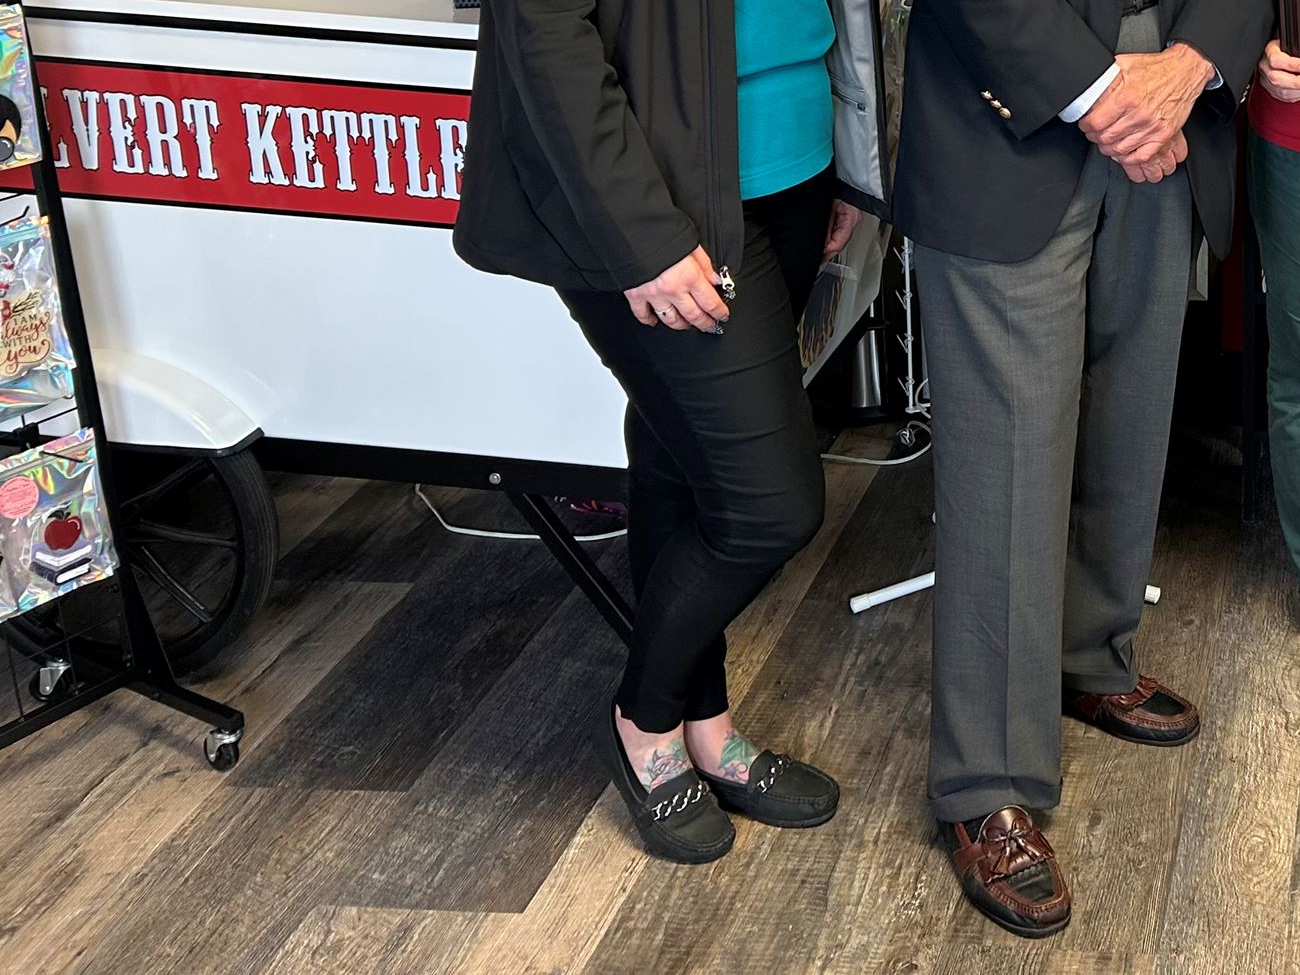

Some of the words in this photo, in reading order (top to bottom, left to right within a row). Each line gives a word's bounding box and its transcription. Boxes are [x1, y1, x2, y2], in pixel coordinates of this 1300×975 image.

[241, 102, 468, 201] KETTLE
[14, 317, 18, 325] I
[20, 314, 37, 324] AM
[2, 334, 31, 348] WITH
[2, 339, 51, 374] you
